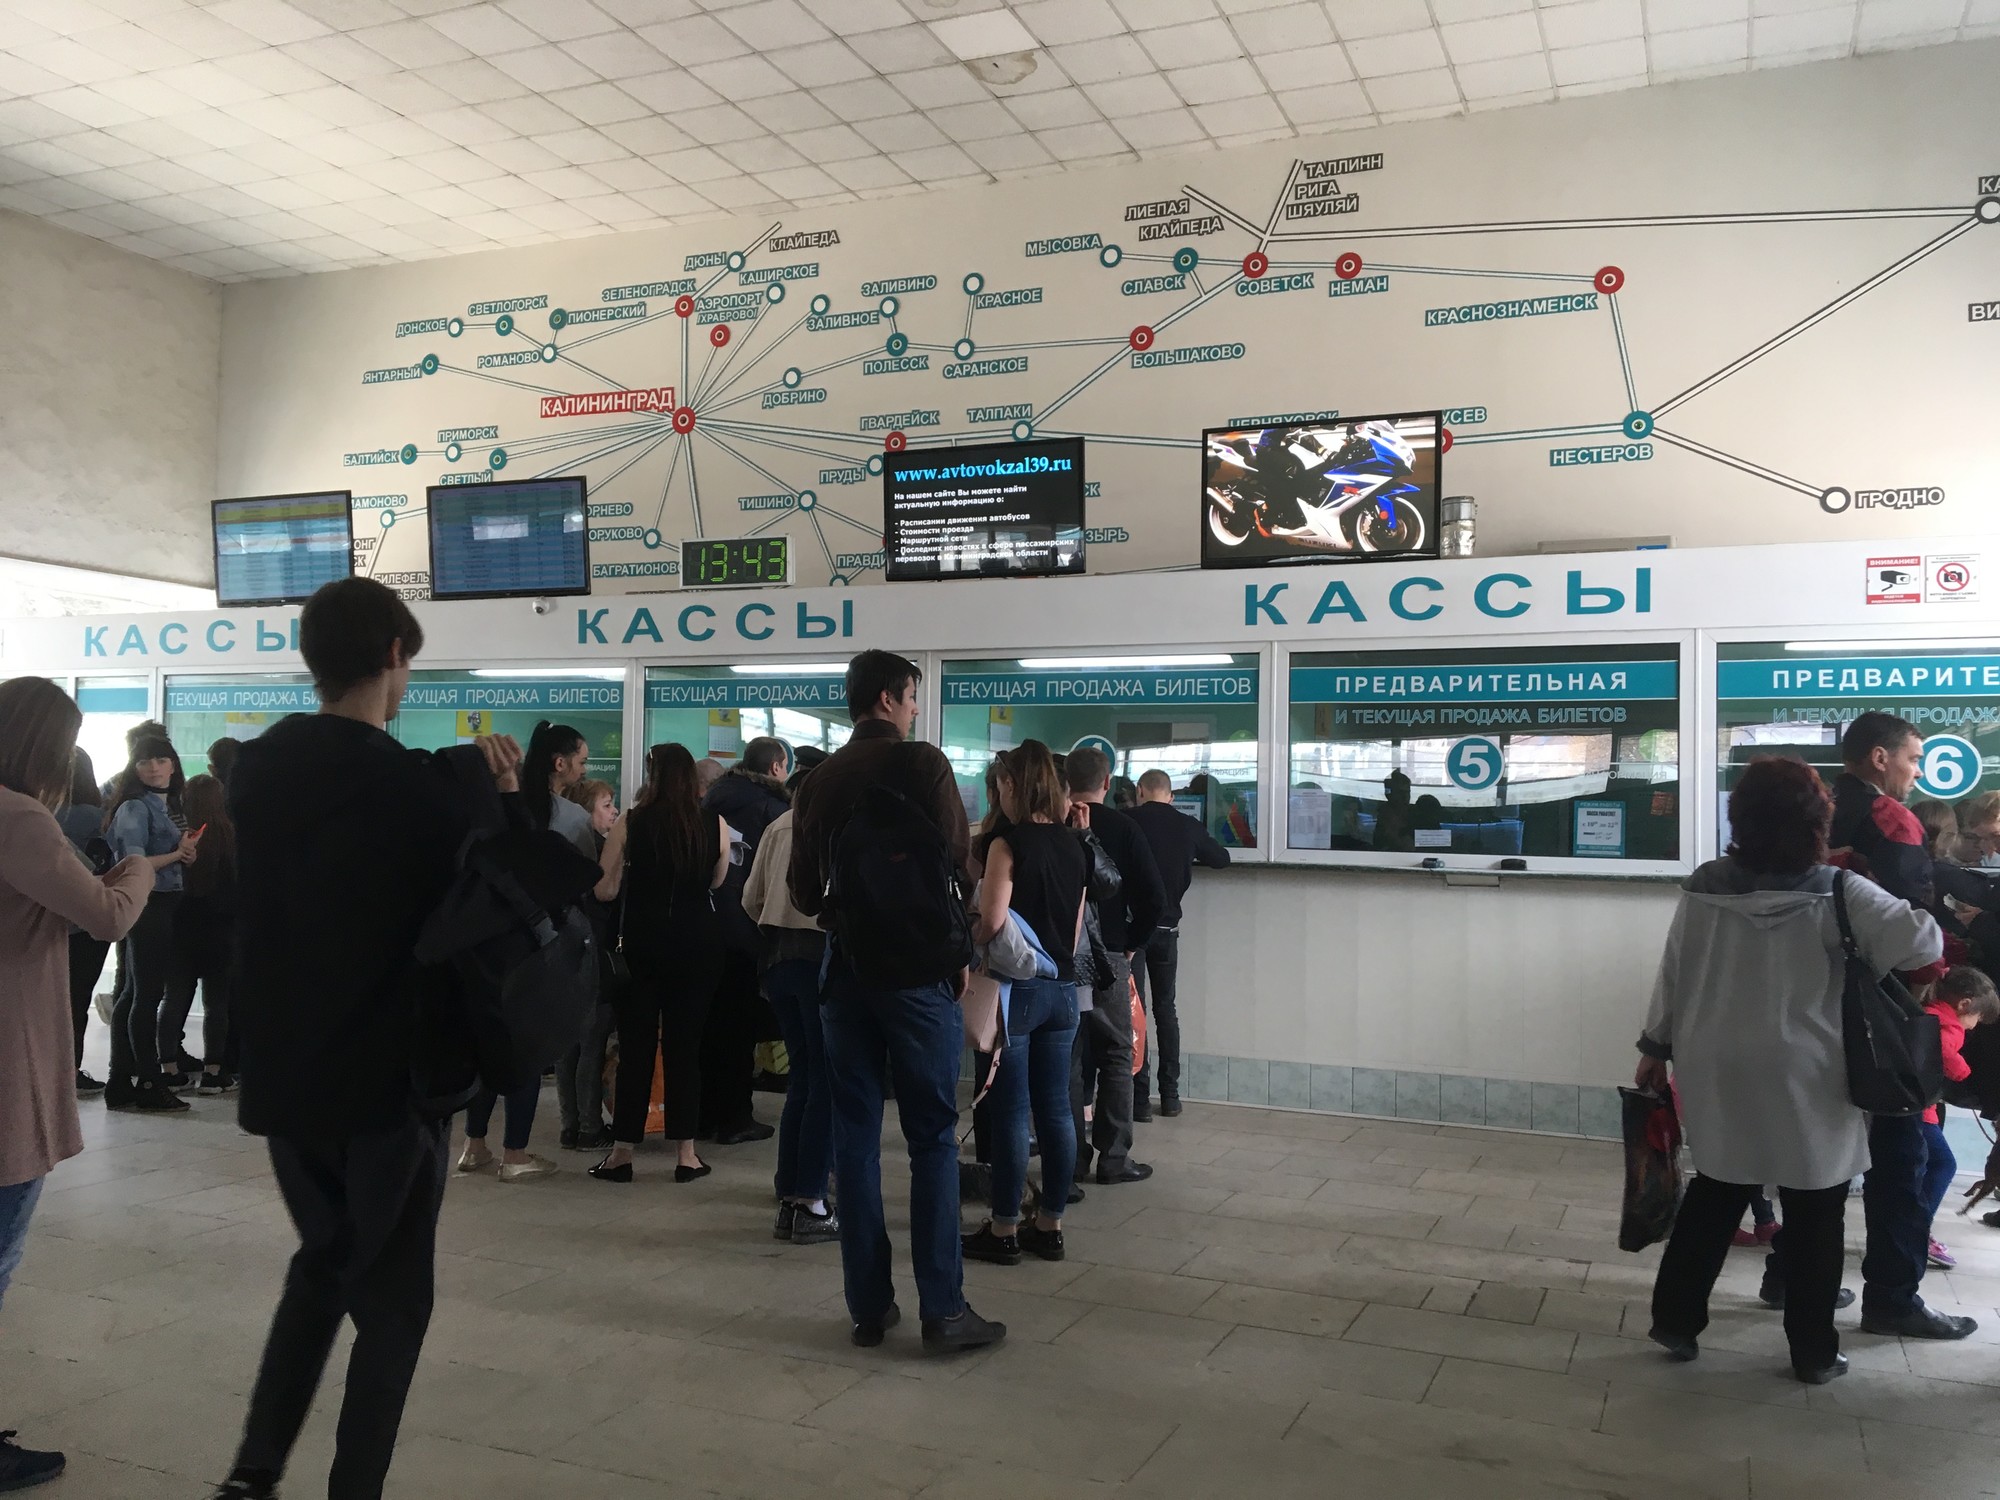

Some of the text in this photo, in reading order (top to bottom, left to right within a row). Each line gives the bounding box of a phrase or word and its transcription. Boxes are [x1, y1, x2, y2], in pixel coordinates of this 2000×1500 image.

[1305, 155, 1383, 178] ТАЛЛИНН
[1296, 180, 1339, 199] РИГА
[1125, 199, 1189, 221] ЛИЕПАЯ
[1287, 194, 1359, 219] ШЯУЛЯЙ
[1139, 216, 1223, 240] КЛАЙПЕДА
[770, 230, 839, 251] КЛАЙПЕДА
[1026, 234, 1102, 256] МЫСОВКА
[685, 253, 727, 270] ДЮНЫ
[739, 264, 818, 285] КАШИРСКОЕ
[1236, 273, 1313, 295] СОВЕТСК
[602, 279, 695, 301] ЗЕЛЕНОГРАДСК
[861, 277, 936, 295] ЗАЛИВИНО
[1122, 276, 1185, 296] СЛАВСК
[1330, 277, 1388, 296] НЕМАН
[467, 296, 547, 316] СВЕТЛОГОРСК
[696, 292, 763, 310] АЭРОПОРТ
[976, 290, 1041, 309] КРАСНОЕ
[568, 304, 646, 324] ПИОНЕРСКИЙ
[1426, 293, 1597, 326] КРАСНОЗНАМЕНСК
[397, 318, 447, 337] ДОНСКОЕ
[807, 312, 878, 331] ЗАЛИВНОЕ
[477, 350, 540, 368] РОМАНОВО
[863, 357, 929, 374] ПОЛЕССК
[1133, 344, 1245, 368] БОЛЬШАКОВО
[362, 365, 421, 383] ЯНТАРНЫЙ
[943, 358, 1027, 377] САРАНСКОЕ
[540, 388, 674, 417] КАЛИНИНГРАД
[762, 389, 825, 408] ДОБРИНО
[861, 410, 938, 429] ГВАРДЕЙСК
[967, 405, 1032, 421] ТАЛПАКИ
[438, 426, 498, 442] ПРИМОРСК
[343, 451, 399, 467] БАЛТИЙСК
[1553, 445, 1652, 466] НЕСТЕРОВ
[439, 471, 492, 485] СВЕТЛЫЙ
[820, 469, 865, 484] ПРУДЫ
[894, 455, 1073, 483] www.avtovokzal39.ru
[351, 495, 407, 509] АМОНОВО
[739, 496, 794, 509] ТИШИНО
[894, 485, 1027, 501] На нашем сайте Вы можете найти
[1857, 488, 1944, 509] ГРОДНО
[894, 500, 941, 510] актуальную
[941, 496, 995, 508] информацию
[900, 518, 946, 528] Расписании
[946, 515, 988, 525] движения
[989, 512, 1031, 522] автобусов
[900, 528, 940, 537] Стоимости
[941, 526, 974, 535] проезда
[900, 535, 949, 545] Маршрутной
[988, 541, 1013, 550] сфере
[700, 540, 786, 582] 13:43
[895, 555, 936, 564] перевозок
[1015, 549, 1049, 558] области
[1244, 567, 1651, 626] КАССЫ
[577, 599, 854, 644] КАССЫ
[83, 617, 302, 658] КАССЫ
[1335, 671, 1627, 696] ПРЕДВАРИТЕЛЬНАЯ
[1772, 665, 2000, 692] ПРЕДВАРИТЕ
[169, 691, 228, 709] ТЕКУЩАЯ
[234, 690, 298, 708] ПРОДАЖА
[465, 688, 540, 707] ПРОДАЖА
[548, 687, 620, 704] БИЛЕТОВ
[651, 685, 728, 706] ТЕКУЩАЯ
[735, 684, 820, 705] ПРОДАЖА
[948, 678, 1252, 702] ТЕКУЩАЯ ПРОДАЖА БИЛЕТОВ
[1335, 707, 1627, 727] И ТЕКУЩАЯ ПРОДАЖА БИЛЕТОВ
[1773, 708, 1788, 724] И
[1457, 745, 1490, 785] 5
[1924, 745, 1964, 790] 6
